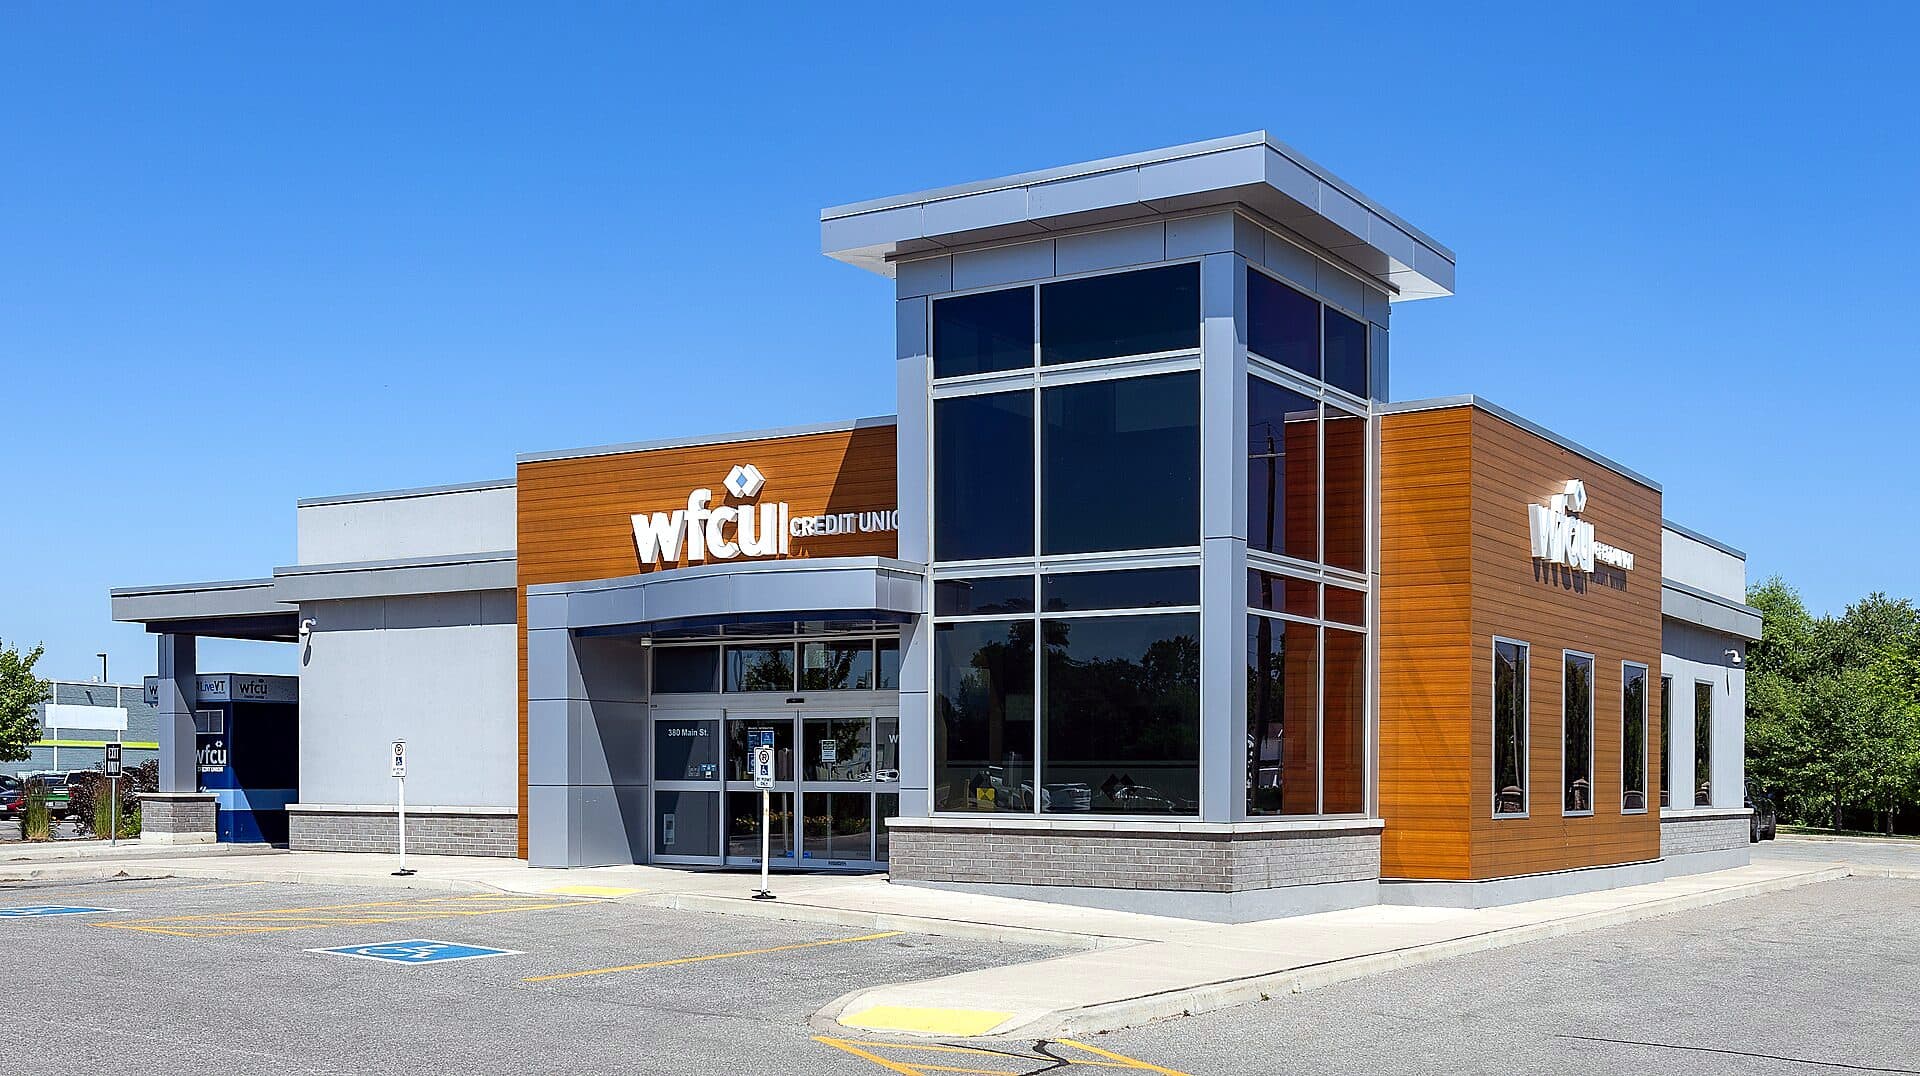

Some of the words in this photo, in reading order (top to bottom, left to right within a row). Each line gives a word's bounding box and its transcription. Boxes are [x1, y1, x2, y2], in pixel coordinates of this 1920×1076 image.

[630, 487, 779, 565] wfcu
[789, 513, 858, 538] CREDIT
[239, 680, 268, 695] wfcu
[667, 728, 681, 737] 380
[681, 728, 698, 737] Main
[698, 728, 710, 737] St.
